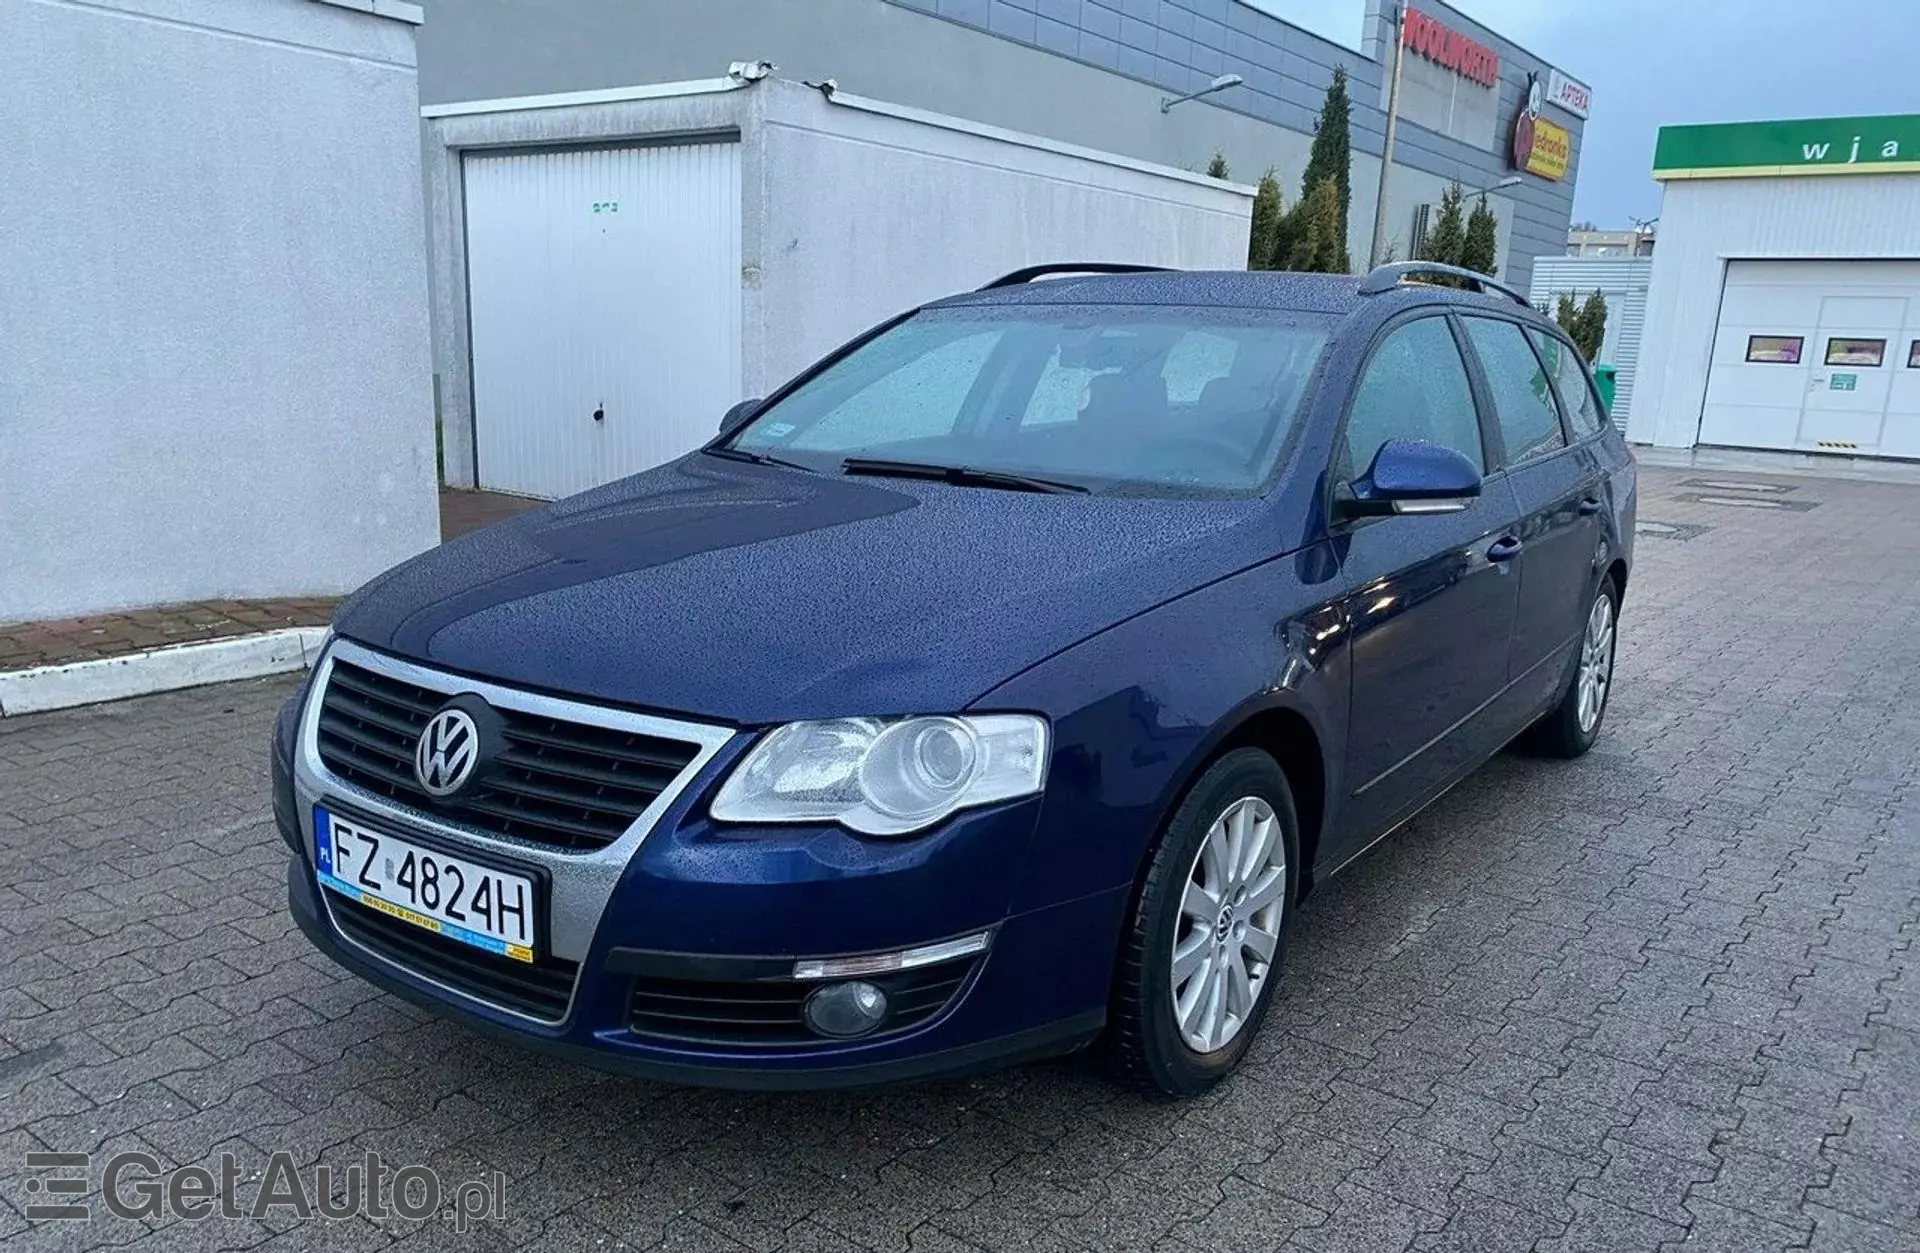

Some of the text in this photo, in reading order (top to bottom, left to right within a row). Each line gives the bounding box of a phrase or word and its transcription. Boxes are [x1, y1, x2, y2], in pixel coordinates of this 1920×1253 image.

[320, 846, 331, 864] PL
[334, 822, 381, 891] FZ
[397, 850, 525, 940] 4824H
